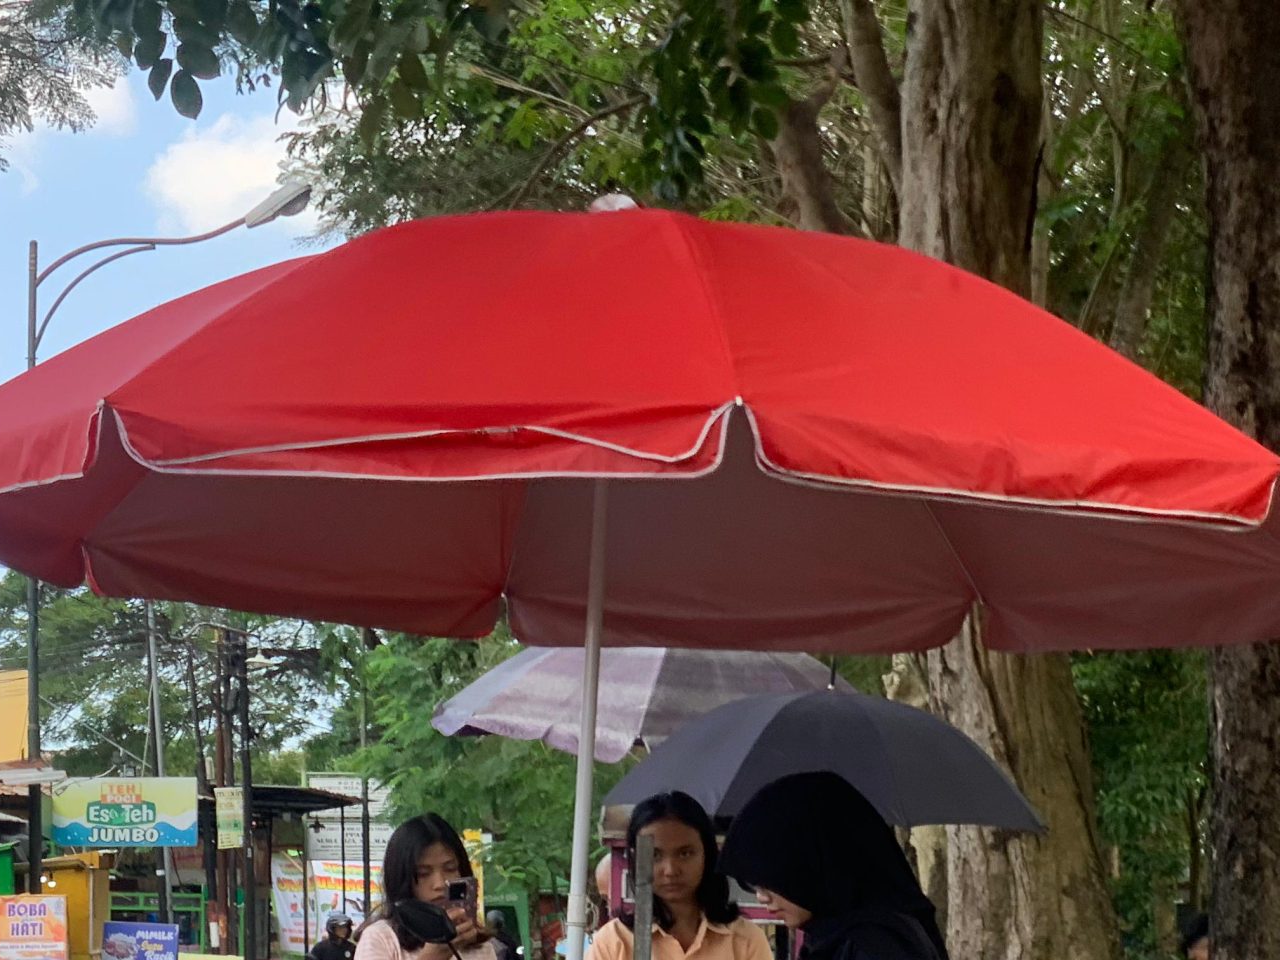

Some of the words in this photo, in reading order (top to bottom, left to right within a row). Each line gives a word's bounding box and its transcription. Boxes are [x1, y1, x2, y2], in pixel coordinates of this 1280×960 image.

[108, 784, 136, 795] TEH
[88, 805, 110, 821] Es
[121, 804, 155, 822] Teh
[87, 827, 160, 843] JUMBO
[7, 903, 47, 918] BOBA
[10, 922, 44, 937] HATI
[135, 930, 174, 940] MIMILK
